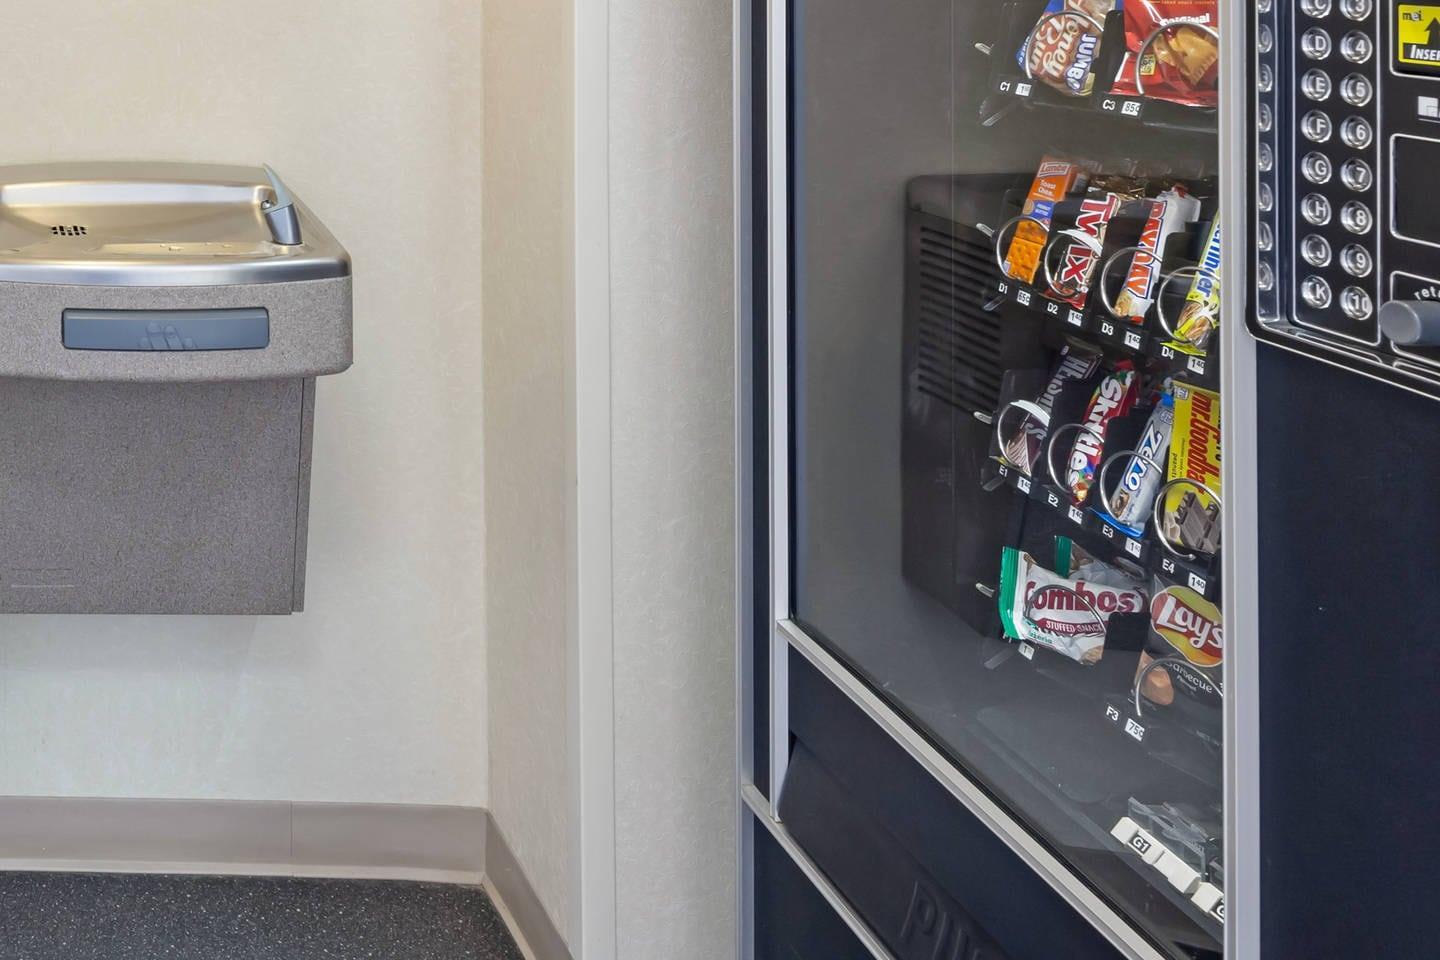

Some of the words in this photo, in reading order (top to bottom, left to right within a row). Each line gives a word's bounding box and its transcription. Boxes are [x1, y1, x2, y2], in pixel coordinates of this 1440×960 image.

[1315, 36, 1327, 51] D
[1355, 40, 1366, 54] 4
[1000, 81, 1011, 91] C1
[1315, 78, 1326, 93] E
[1356, 82, 1365, 97] 5
[1103, 99, 1116, 111] C3
[1316, 119, 1326, 134] F
[1356, 125, 1366, 140] 6
[1315, 160, 1327, 176] G
[1356, 168, 1366, 183] 7
[1315, 201, 1327, 216] H
[1356, 211, 1365, 226] 8
[1316, 244, 1326, 259] J
[1355, 253, 1366, 268] 9
[998, 283, 1008, 294] D1
[1315, 284, 1327, 300] K
[1047, 302, 1058, 315] D2
[1353, 295, 1371, 312] 10
[1101, 322, 1114, 336] D3
[1161, 345, 1175, 360] D4
[999, 465, 1008, 477] E1
[1047, 493, 1059, 507] E2
[1102, 524, 1114, 538] E3
[1162, 559, 1175, 574] E4
[1046, 620, 1076, 633] STUFFED
[1106, 705, 1119, 721] F3
[1132, 836, 1149, 852] G1
